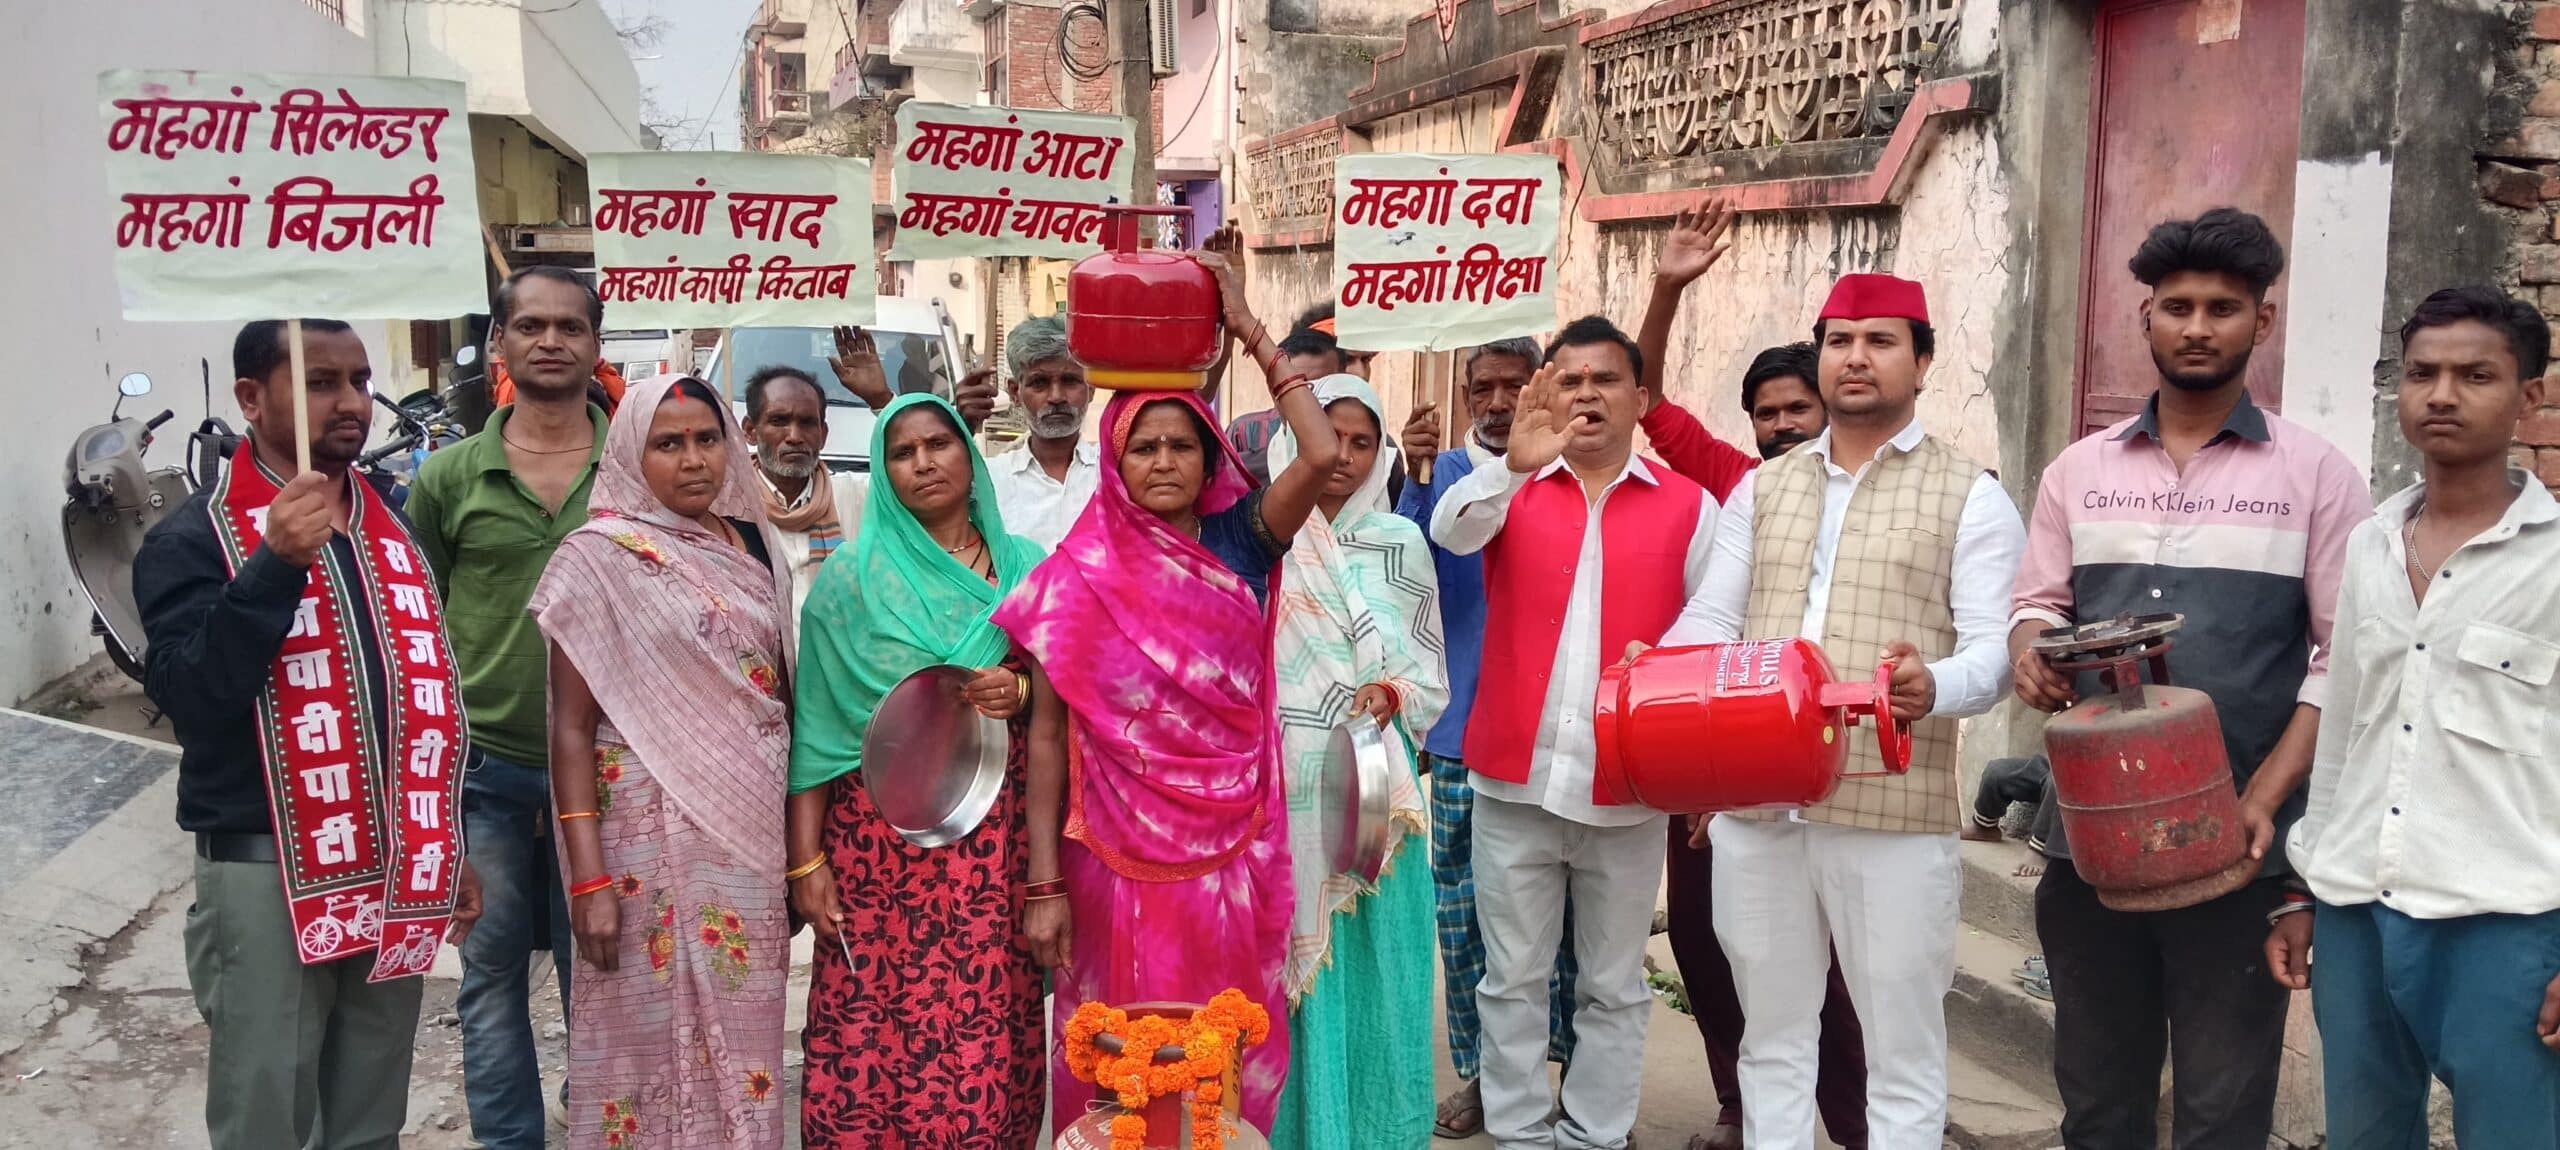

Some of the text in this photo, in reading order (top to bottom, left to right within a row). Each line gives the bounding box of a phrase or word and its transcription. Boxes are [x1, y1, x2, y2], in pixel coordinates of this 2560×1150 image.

[107, 86, 450, 163] महगां सिलेन्डर
[906, 114, 1123, 181] महगां आटा
[116, 173, 445, 252] महगां बिजली
[595, 178, 838, 249] महगां खाद
[900, 188, 1013, 239] महगां
[1342, 167, 1542, 229] महगां दवा
[600, 253, 857, 304] महगां कापी किताब
[1341, 243, 1547, 311] महगां शिक्षा
[2083, 489, 2146, 510] Calvin
[2222, 494, 2291, 516] Jeans
